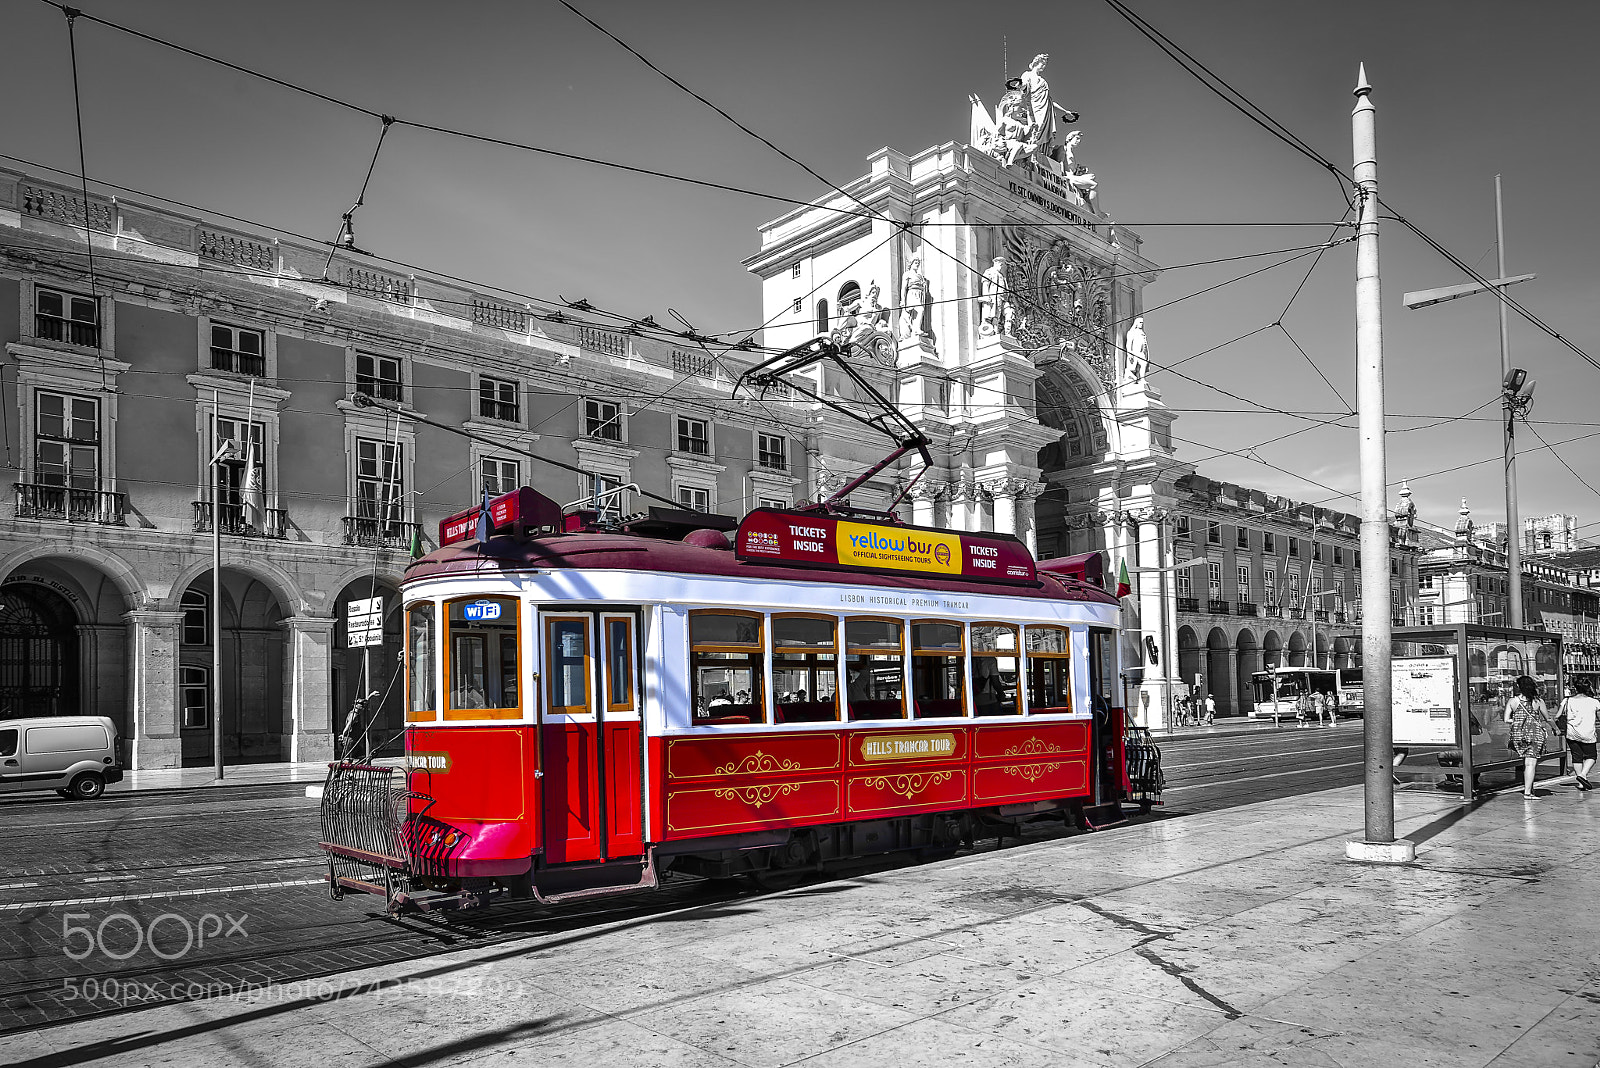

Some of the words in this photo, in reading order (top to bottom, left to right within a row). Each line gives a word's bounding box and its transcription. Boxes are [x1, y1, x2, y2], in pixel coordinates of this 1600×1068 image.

[789, 525, 827, 539] TICKETS
[793, 540, 825, 553] INSIDE
[849, 531, 905, 552] yellow
[907, 536, 932, 554] bus
[853, 550, 878, 560] OFFICIAL
[878, 553, 914, 563] SIGHTSEEING
[914, 556, 932, 564] TOURS
[969, 545, 998, 557] TICKETS
[973, 558, 997, 569] INSIDE
[840, 594, 865, 603] LISBON
[869, 596, 907, 606] HISTORICAL
[911, 598, 939, 608] PREMIUM
[943, 600, 969, 609] TRAMCAR
[866, 741, 893, 755] HILLS
[930, 738, 951, 752] TOUR
[428, 755, 447, 769] TOUR
